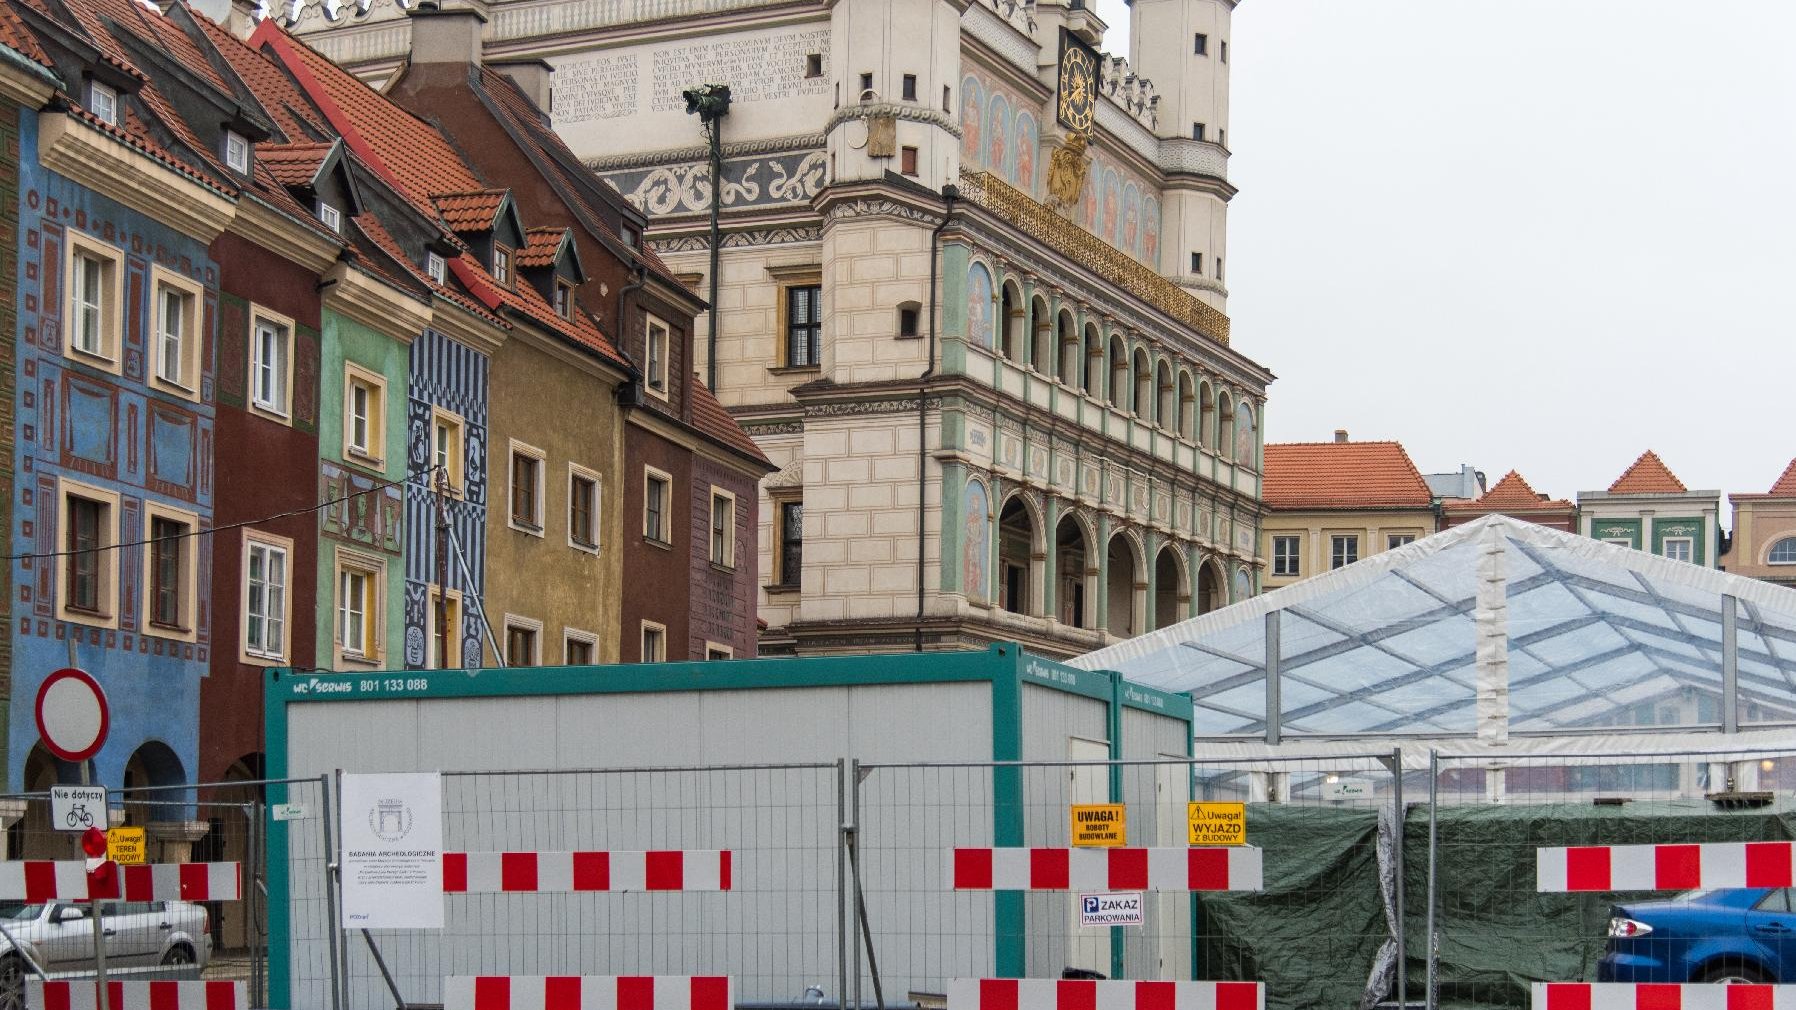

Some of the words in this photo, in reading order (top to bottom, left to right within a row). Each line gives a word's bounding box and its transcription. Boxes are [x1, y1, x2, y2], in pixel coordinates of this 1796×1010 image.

[653, 49, 669, 58] NON
[673, 47, 685, 55] EST
[360, 680, 380, 692] 801
[384, 679, 404, 691] 133
[407, 679, 428, 691] 088
[54, 789, 69, 799] Nie
[72, 789, 103, 802] dotyczy
[1207, 811, 1241, 822] Uwaga!
[1193, 823, 1241, 833] WYJAZD
[119, 835, 143, 845] Uwaga!
[1079, 832, 1118, 841] BUDOWLANE
[1195, 834, 1200, 842] Z
[1202, 834, 1239, 842] BUDOWY
[116, 845, 137, 853] TEREN
[112, 854, 141, 862] BUDOWY
[1101, 899, 1138, 911] ZAKAZ
[1084, 913, 1140, 923] PARKOWANIA
